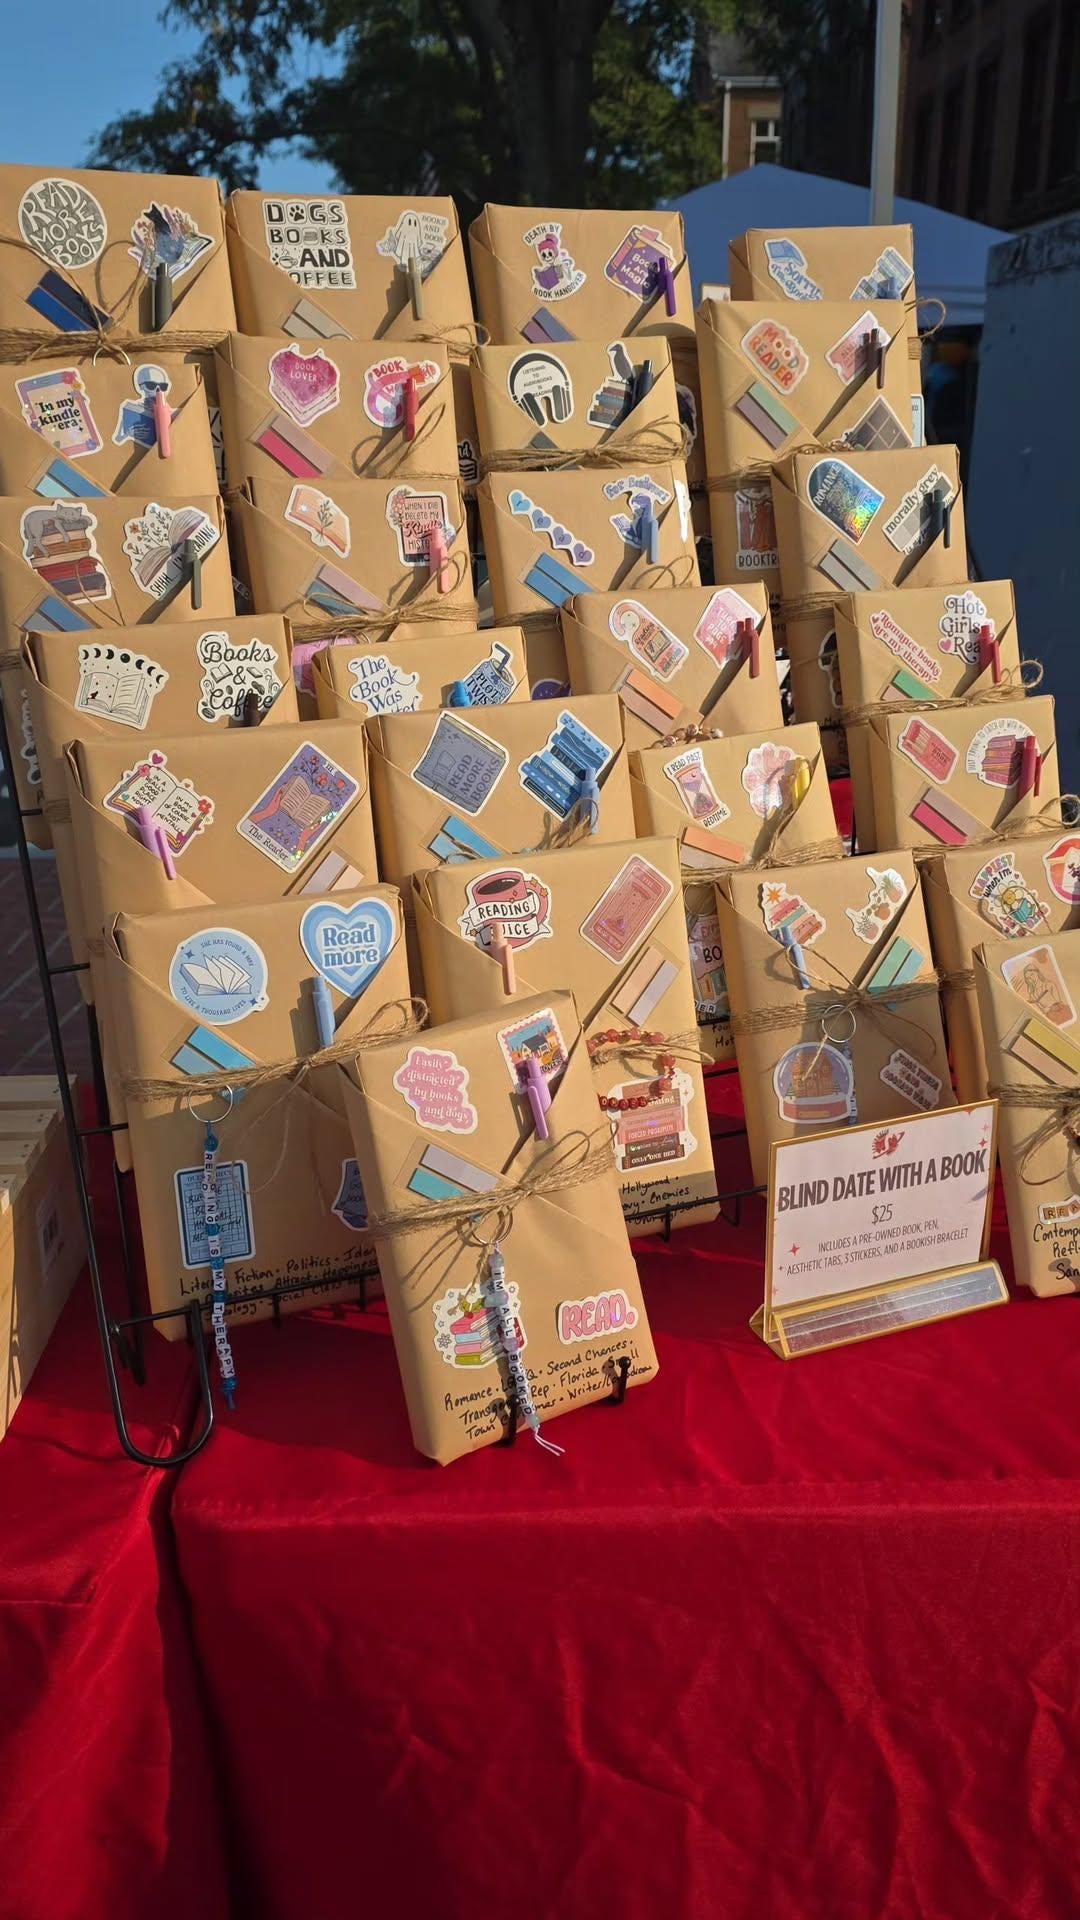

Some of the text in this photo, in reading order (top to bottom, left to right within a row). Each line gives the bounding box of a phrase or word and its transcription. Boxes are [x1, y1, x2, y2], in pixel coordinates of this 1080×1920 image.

[22, 179, 82, 232] READ
[30, 197, 95, 251] MORE
[525, 224, 560, 244] DEATH BY
[50, 223, 105, 267] BOOKS
[300, 248, 350, 267] AND
[289, 272, 352, 285] OFFEE
[534, 273, 584, 299] BOOK HANGOVER
[372, 361, 404, 378] BOOK
[749, 336, 793, 386] READER
[290, 371, 318, 382] LOVER
[39, 397, 76, 413] In my
[38, 408, 81, 427] kindle
[58, 420, 78, 430] era
[814, 464, 842, 507] ROMANCE
[885, 492, 919, 534] morally
[918, 468, 941, 495] grey
[193, 527, 217, 553] EADING
[409, 539, 431, 551] HISTO
[738, 554, 779, 568] BOOKTR
[946, 597, 984, 615] Hot
[942, 617, 981, 637] Girls
[203, 641, 275, 663] Books
[874, 624, 938, 684] are my therapy
[880, 612, 941, 676] Romance books
[953, 637, 981, 663] Rea
[233, 666, 246, 685] &
[350, 656, 387, 679] The
[352, 668, 417, 700] Book
[477, 673, 500, 698] PLOT
[367, 688, 403, 713] Was
[449, 754, 473, 790] READ
[671, 758, 686, 772] READ
[146, 776, 165, 793] REALLY
[460, 757, 486, 797] MORE
[471, 756, 501, 802] BOOKS
[135, 791, 152, 805] RIGHT
[140, 787, 156, 803] PLACE
[144, 782, 159, 796] GOOD
[173, 801, 188, 814] BOOK
[184, 801, 192, 809] MY
[167, 813, 181, 824] NOT
[703, 807, 728, 828] BEDTIME
[248, 824, 289, 862] The Reader
[973, 855, 1013, 896] HAPPIEST
[983, 878, 1001, 898] when
[478, 901, 531, 919] READING
[323, 924, 376, 947] Read
[200, 940, 212, 948] SHE
[225, 940, 242, 952] FOUND
[324, 948, 378, 967] more
[180, 987, 187, 995] TO
[184, 994, 195, 1007] LIVE
[201, 1007, 231, 1015] THOUSAND
[232, 1000, 246, 1011] LIVES
[415, 1055, 449, 1069] Easily
[407, 1070, 461, 1086] distracted
[414, 1087, 459, 1102] by books
[424, 1105, 469, 1123] and dogs
[631, 1155, 647, 1164] ONLY
[649, 1152, 661, 1160] ONE
[622, 1176, 670, 1196] Hollywood
[778, 1149, 987, 1212] BLIND DATE WITH A BOOK
[649, 1187, 690, 1204] Enemies
[871, 1204, 894, 1225] $25
[1047, 1204, 1080, 1219] REA
[818, 1220, 939, 1253] INCLUDES A PRE-OWNED BOOK, PEN,
[787, 1228, 968, 1276] AESTHETIC TABS, 3 STICKERS, AND A BOOKISH BRACELET
[235, 1245, 377, 1284] Fiction Politics Iden
[502, 1307, 513, 1337] ALL
[445, 1340, 628, 1411] Romance Second Chances
[510, 1354, 532, 1415] BOOKED
[530, 1384, 549, 1399] Rep
[560, 1367, 599, 1387] Florida
[465, 1423, 495, 1440] Town
